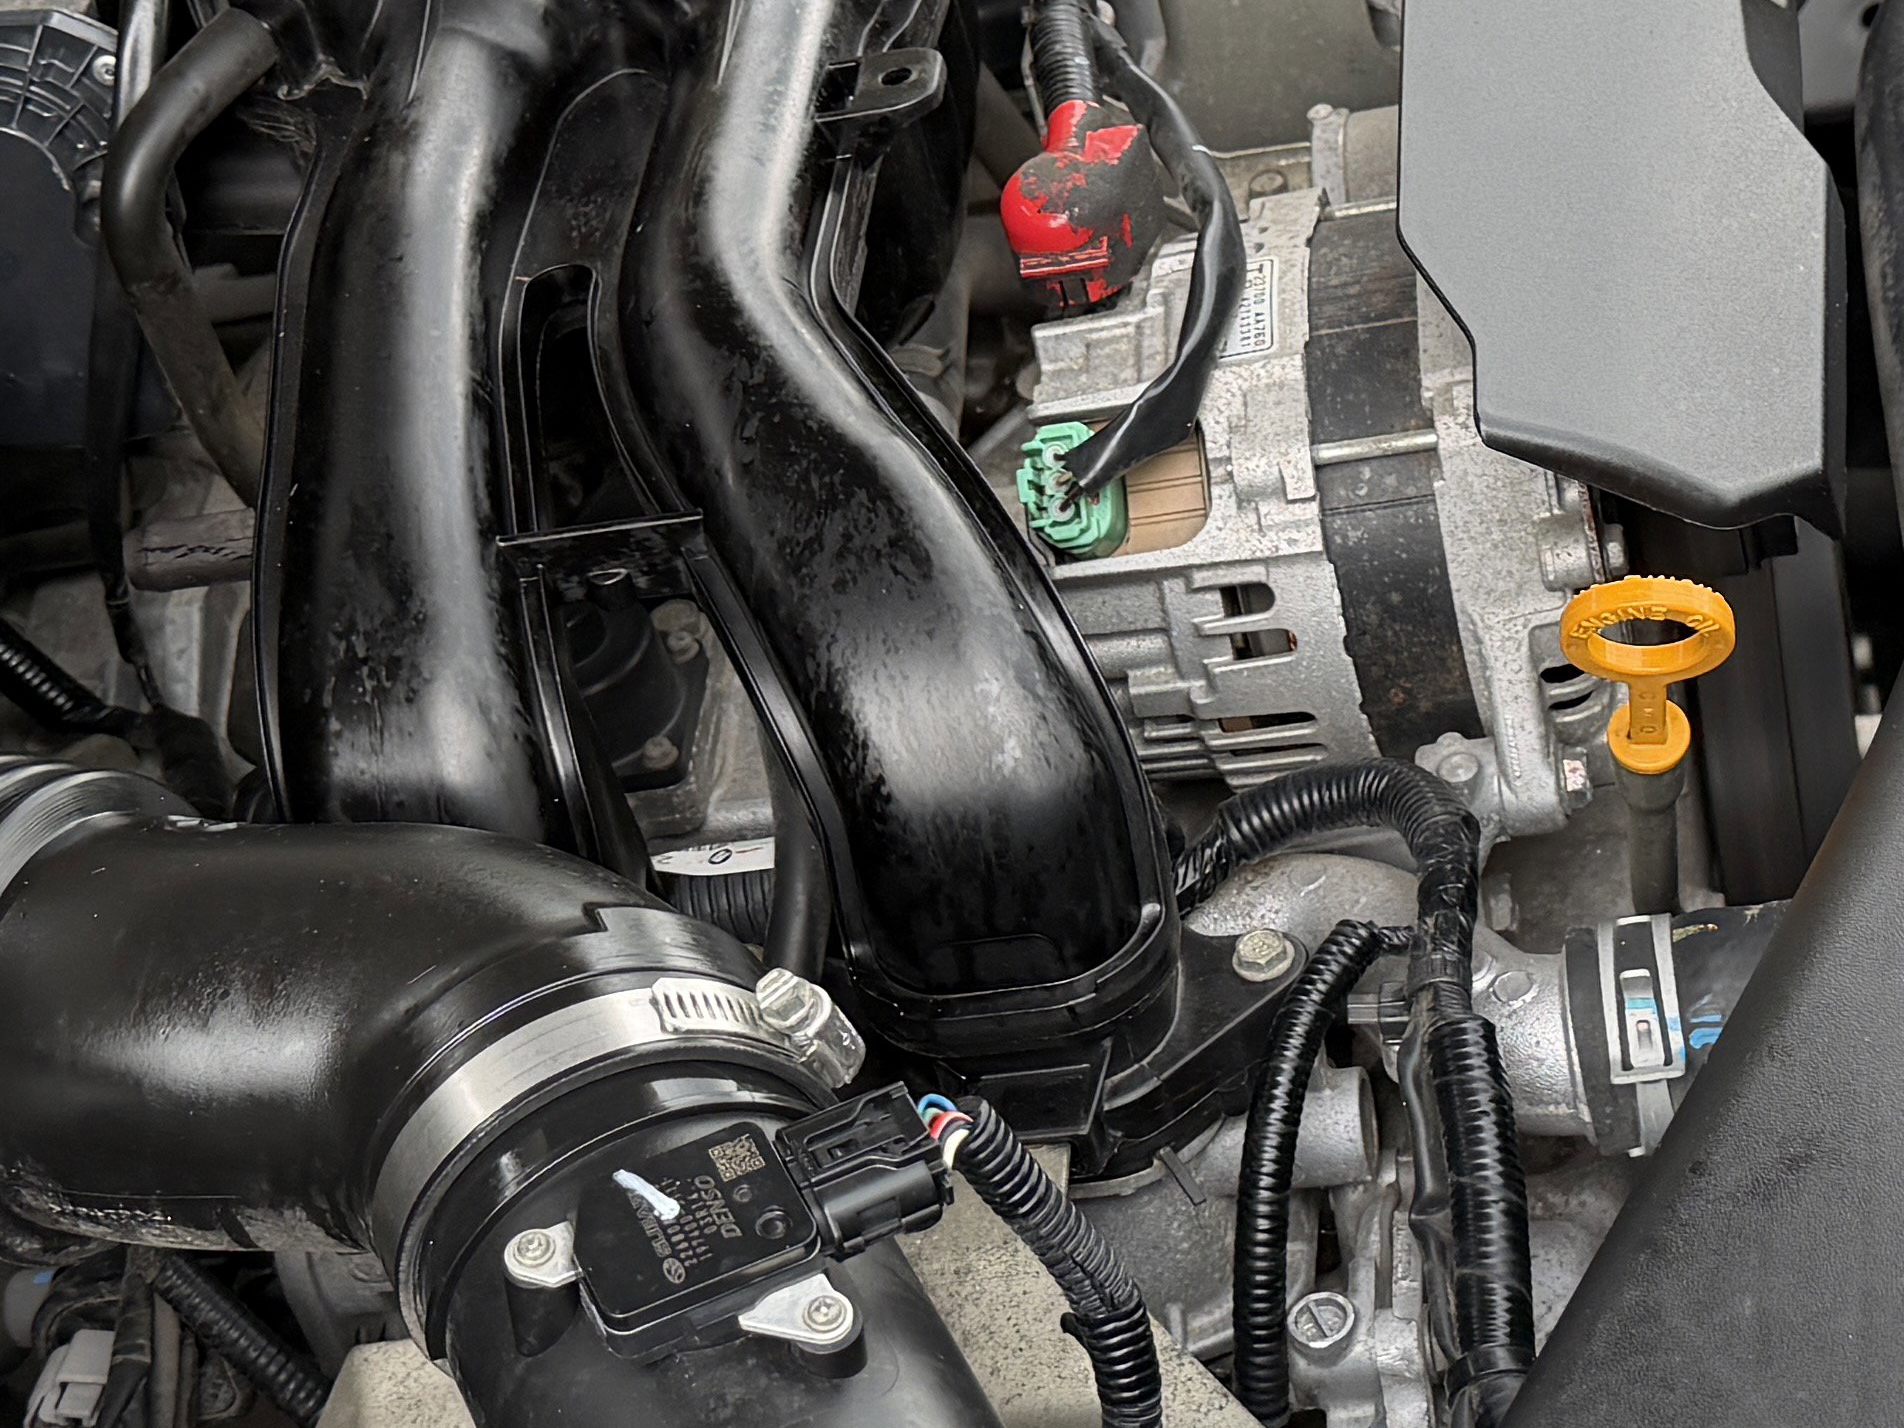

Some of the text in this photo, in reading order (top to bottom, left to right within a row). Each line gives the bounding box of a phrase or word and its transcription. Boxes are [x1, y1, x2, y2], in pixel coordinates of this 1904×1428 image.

[1569, 605, 1720, 639] ENGINE OIL
[626, 1188, 672, 1259] SUBAR
[693, 1171, 742, 1243] DENSO
